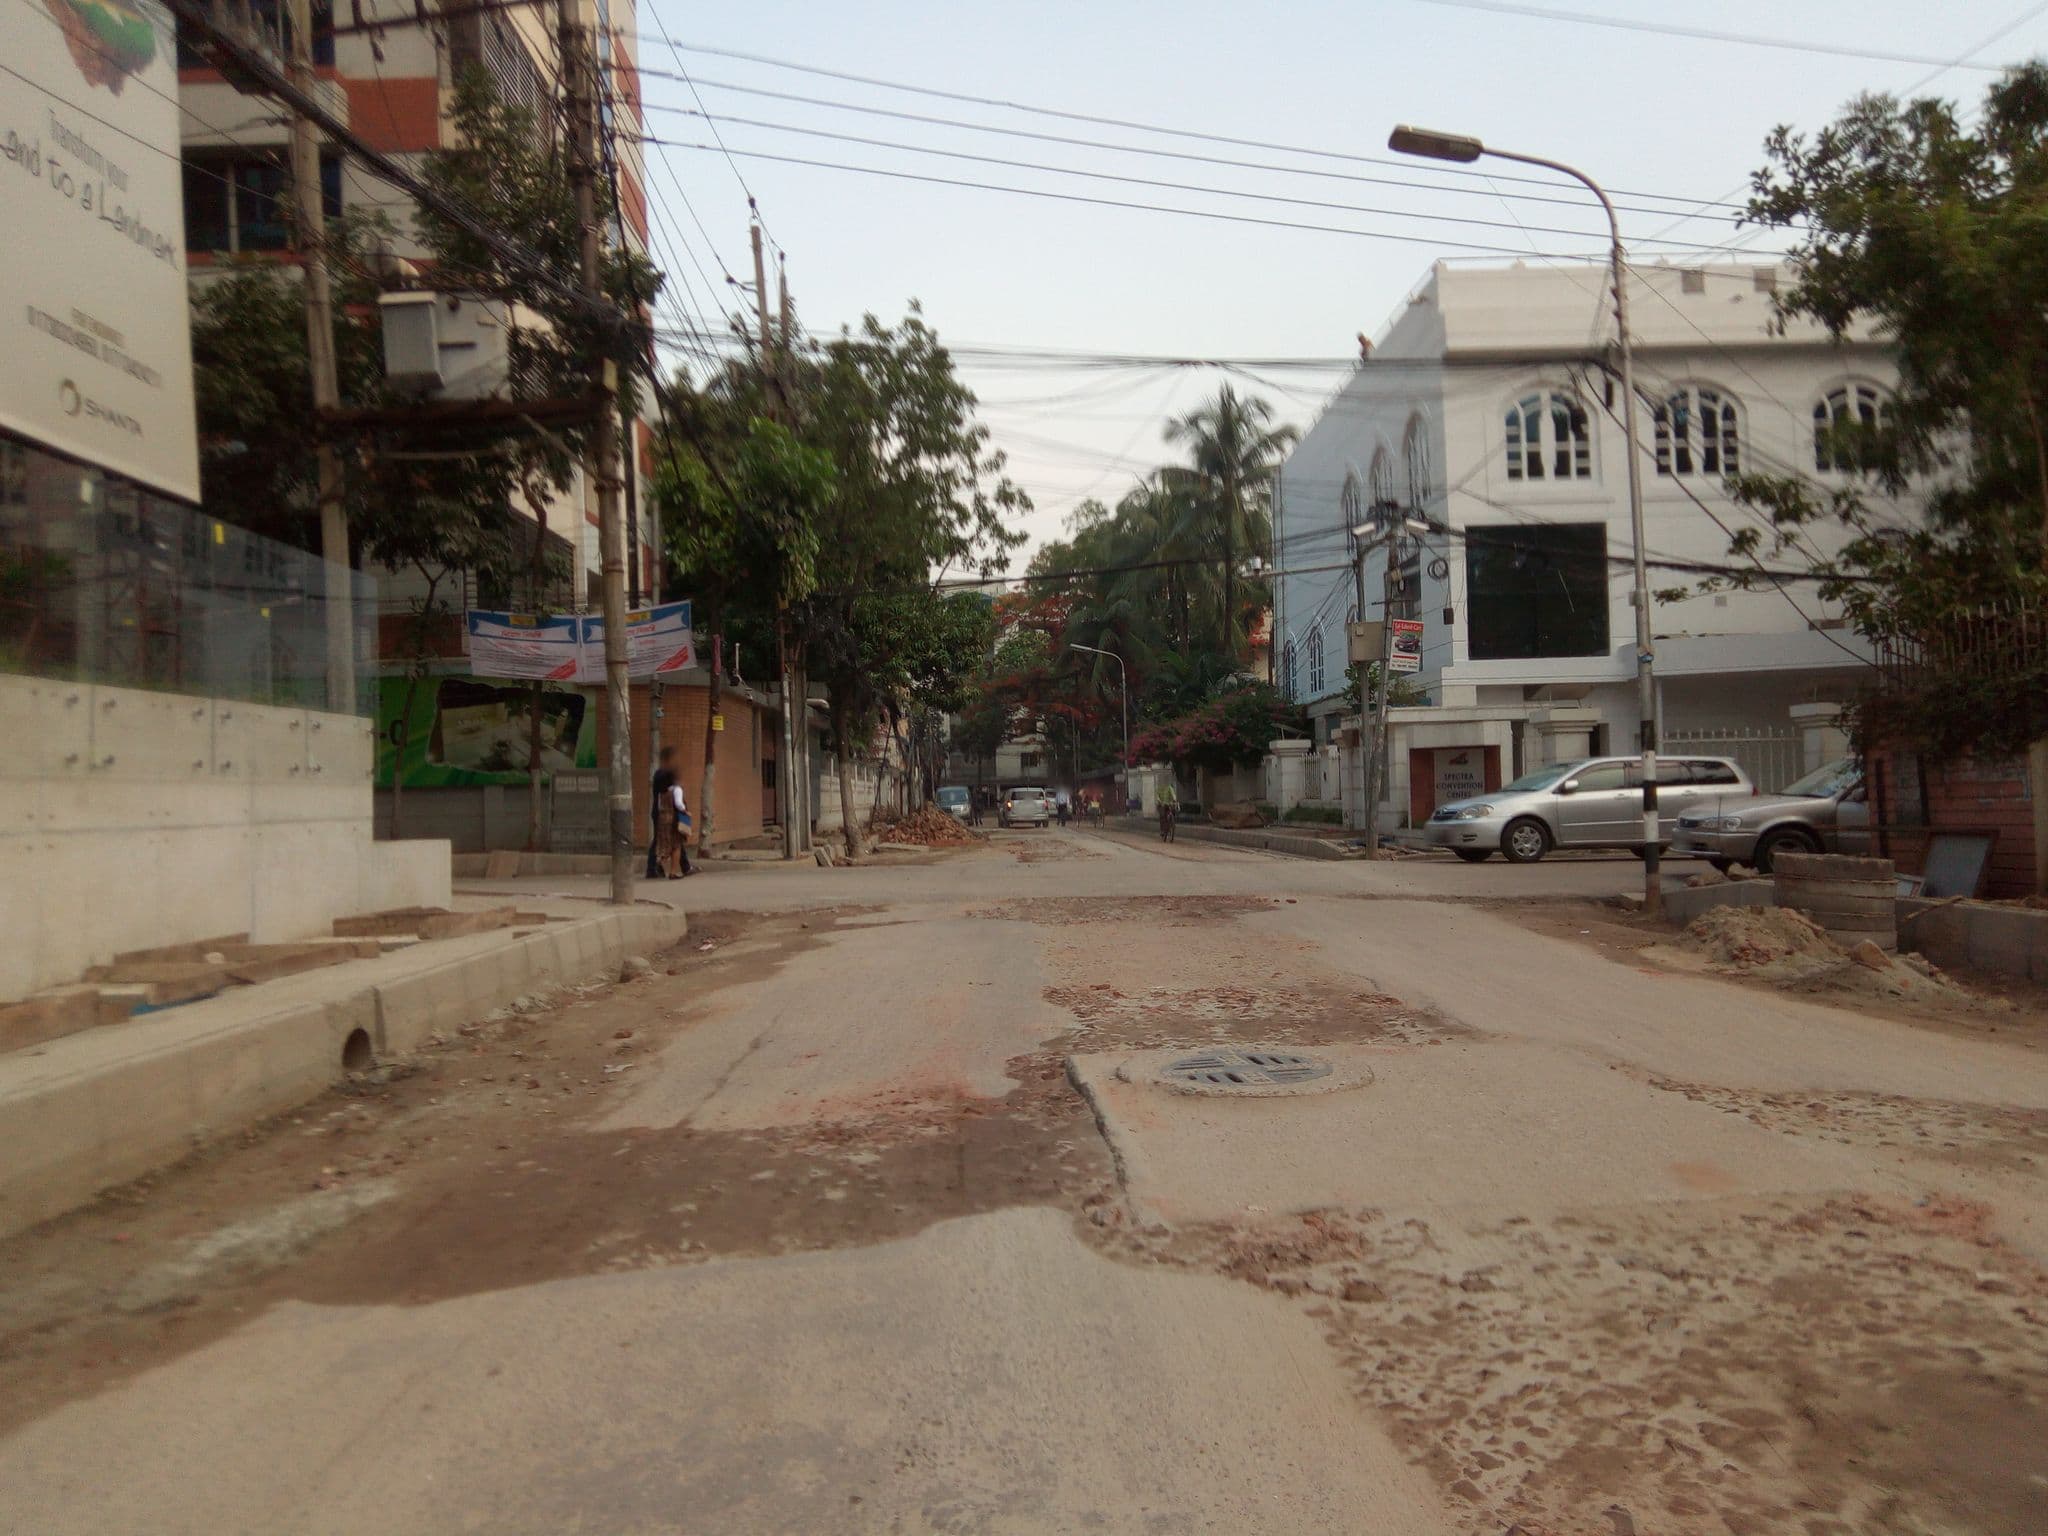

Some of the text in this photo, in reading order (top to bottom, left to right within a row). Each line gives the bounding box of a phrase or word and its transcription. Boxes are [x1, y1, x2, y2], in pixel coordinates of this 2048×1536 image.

[47, 158, 75, 199] to
[82, 182, 93, 211] a
[1436, 780, 1484, 791] CONVENTION
